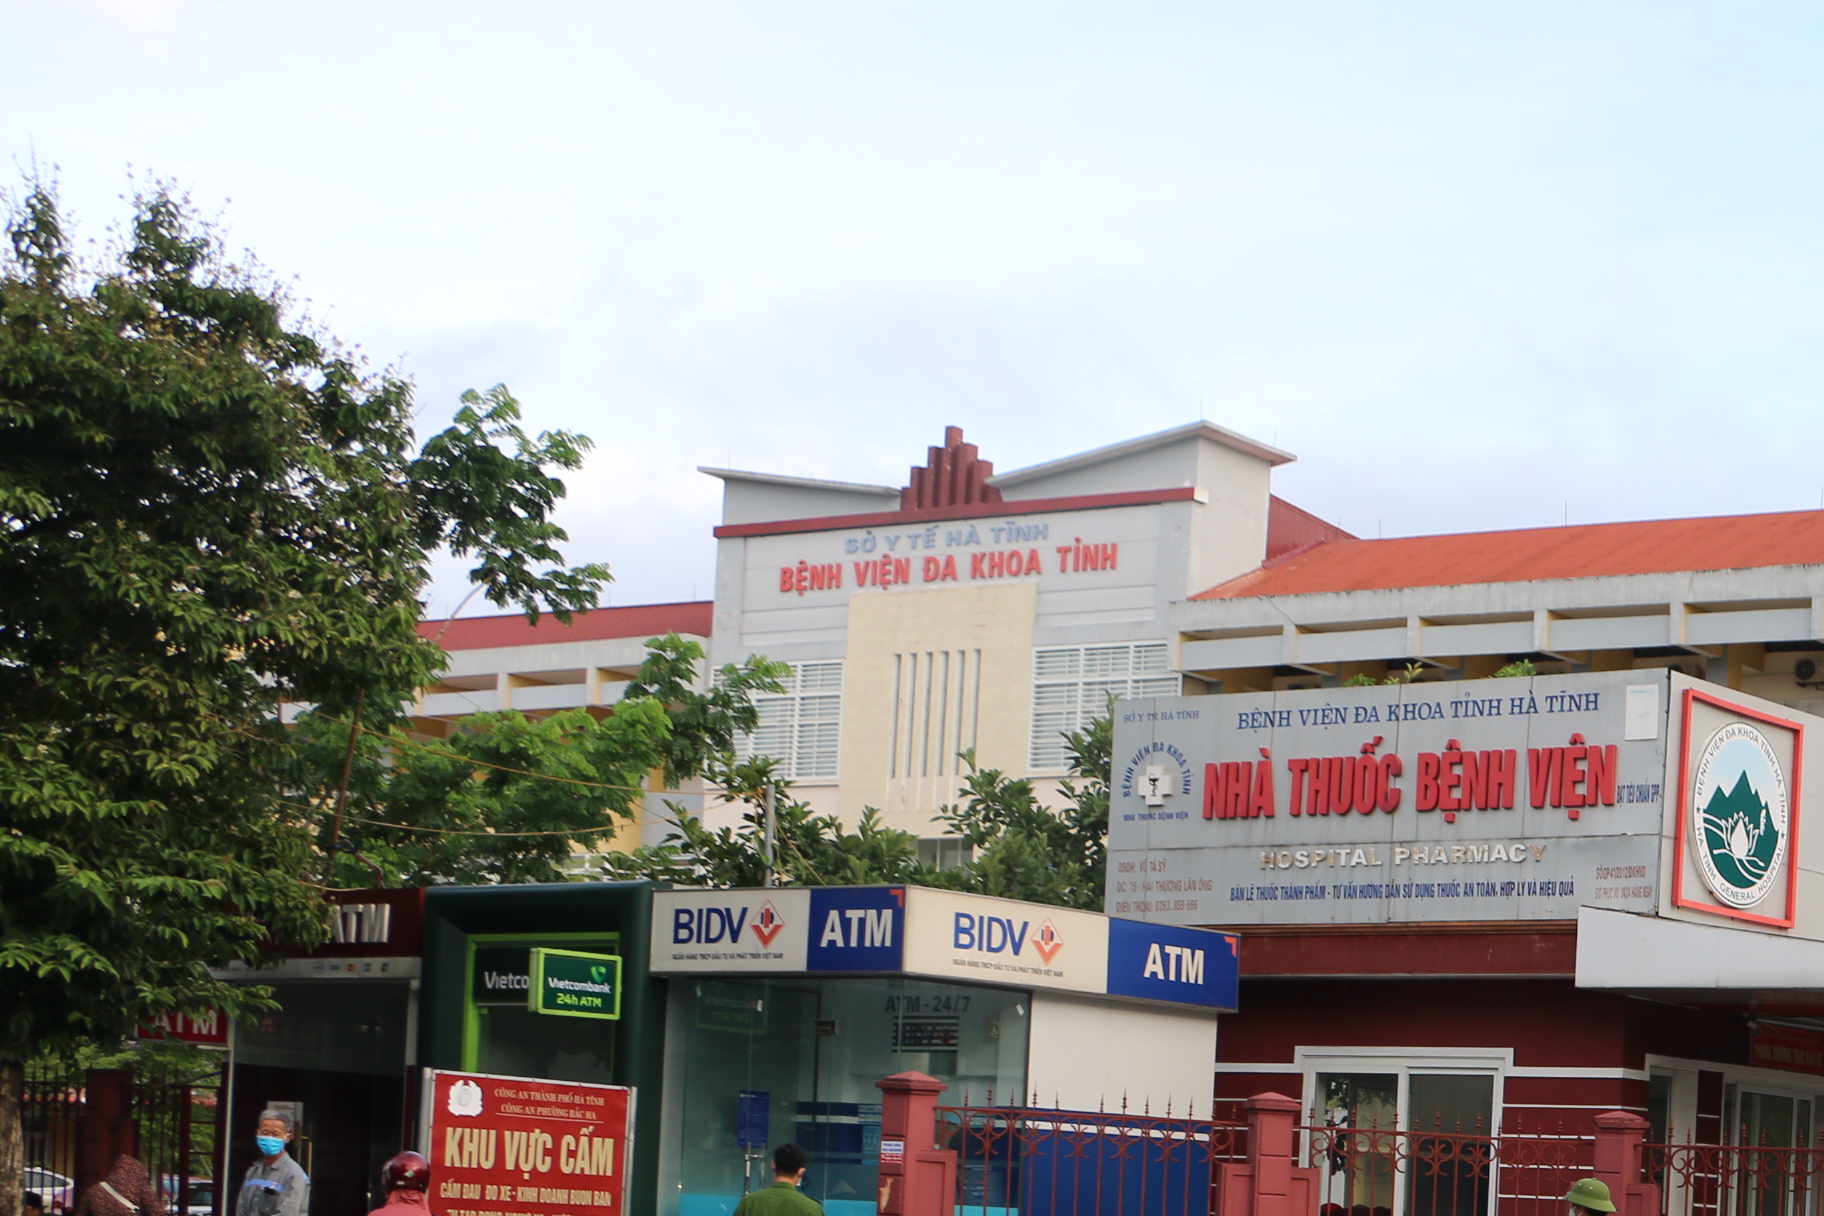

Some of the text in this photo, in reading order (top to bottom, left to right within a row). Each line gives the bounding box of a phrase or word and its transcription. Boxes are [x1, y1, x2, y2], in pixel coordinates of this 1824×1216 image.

[844, 530, 875, 553] SỞ
[884, 534, 900, 552] Y
[908, 524, 940, 549] TẾ
[946, 523, 981, 547] HÀ
[779, 536, 1118, 596] BỆNH VIỆN ĐA KHOA TỈNH
[1237, 690, 1600, 733] BỆNH VIỆN ĐA KHOA TỈNH HÀ TĨNH
[1737, 727, 1760, 744] KHOA
[1202, 732, 1618, 823] NHÀ THUỐC BỆNH VIỆN
[1259, 843, 1548, 870] HOSPITAL PHARMACY
[1719, 882, 1756, 901] GENERAL
[1757, 845, 1784, 894] HOSPITAL
[672, 907, 748, 945] BIDV
[820, 909, 893, 947] ATM
[953, 911, 1029, 956] BIDV
[484, 971, 529, 990] Vietco
[1143, 943, 1205, 985] ATM
[548, 977, 611, 994] Vietcombank
[556, 992, 602, 1008] 24h ATM
[517, 1090, 529, 1099] AN
[444, 1125, 615, 1180] KHU VỰC CẤM
